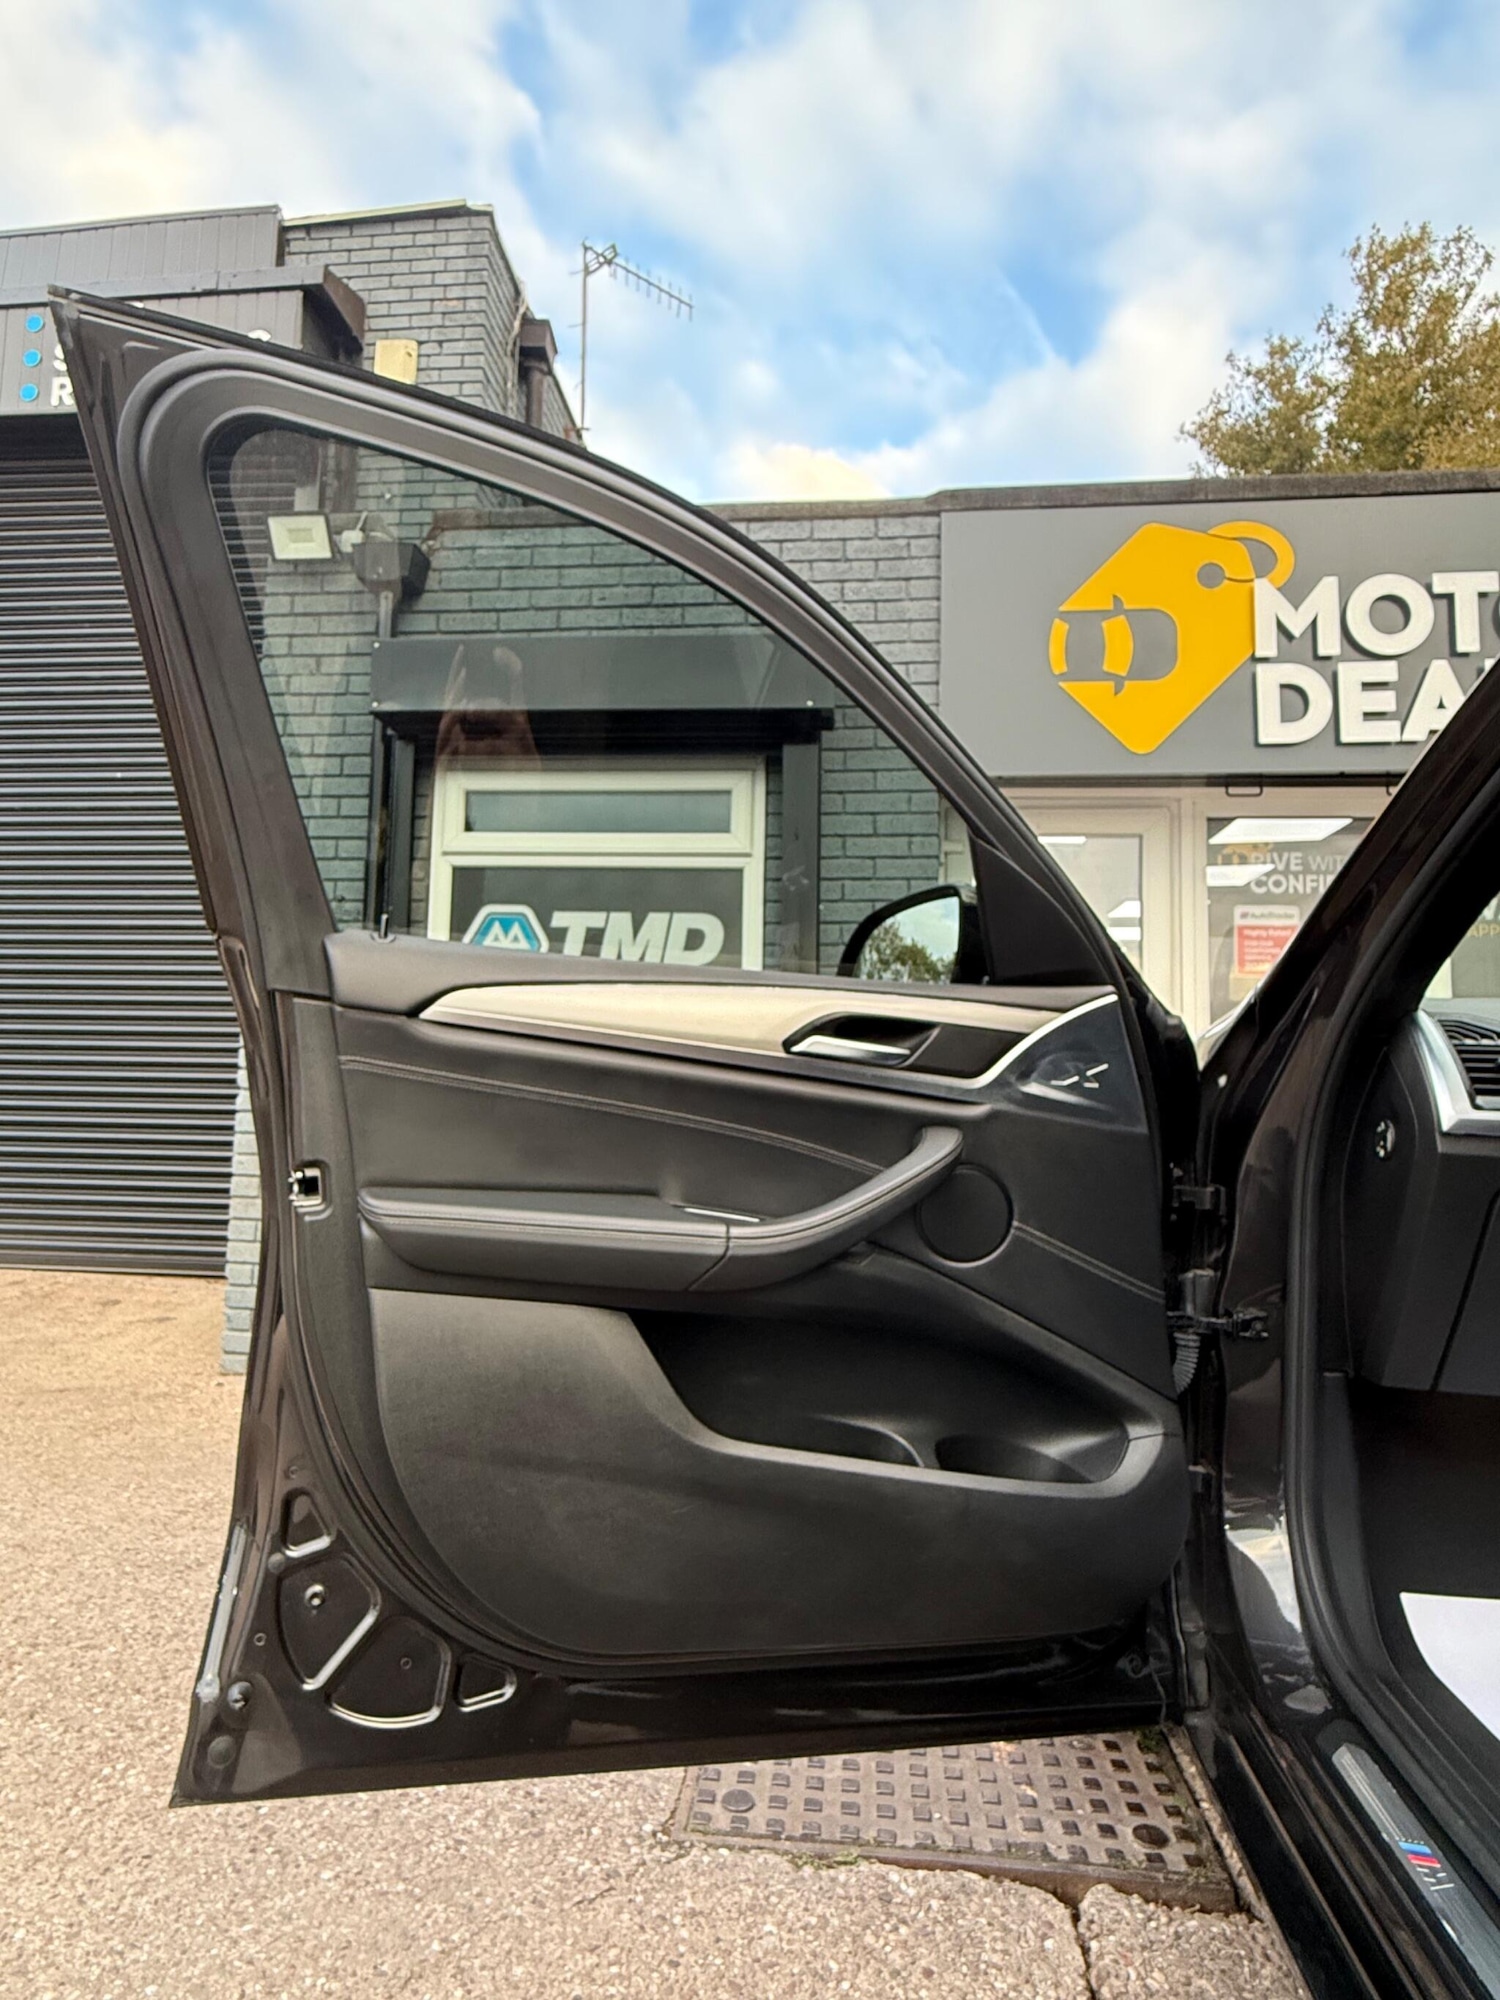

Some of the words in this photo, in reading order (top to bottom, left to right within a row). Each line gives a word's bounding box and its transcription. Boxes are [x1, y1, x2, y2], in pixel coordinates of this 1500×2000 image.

[1254, 570, 1500, 659] MOT
[1256, 658, 1494, 745] DEA
[1250, 874, 1335, 894] CONFI
[1308, 854, 1346, 871] WIT
[550, 911, 725, 966] TMD
